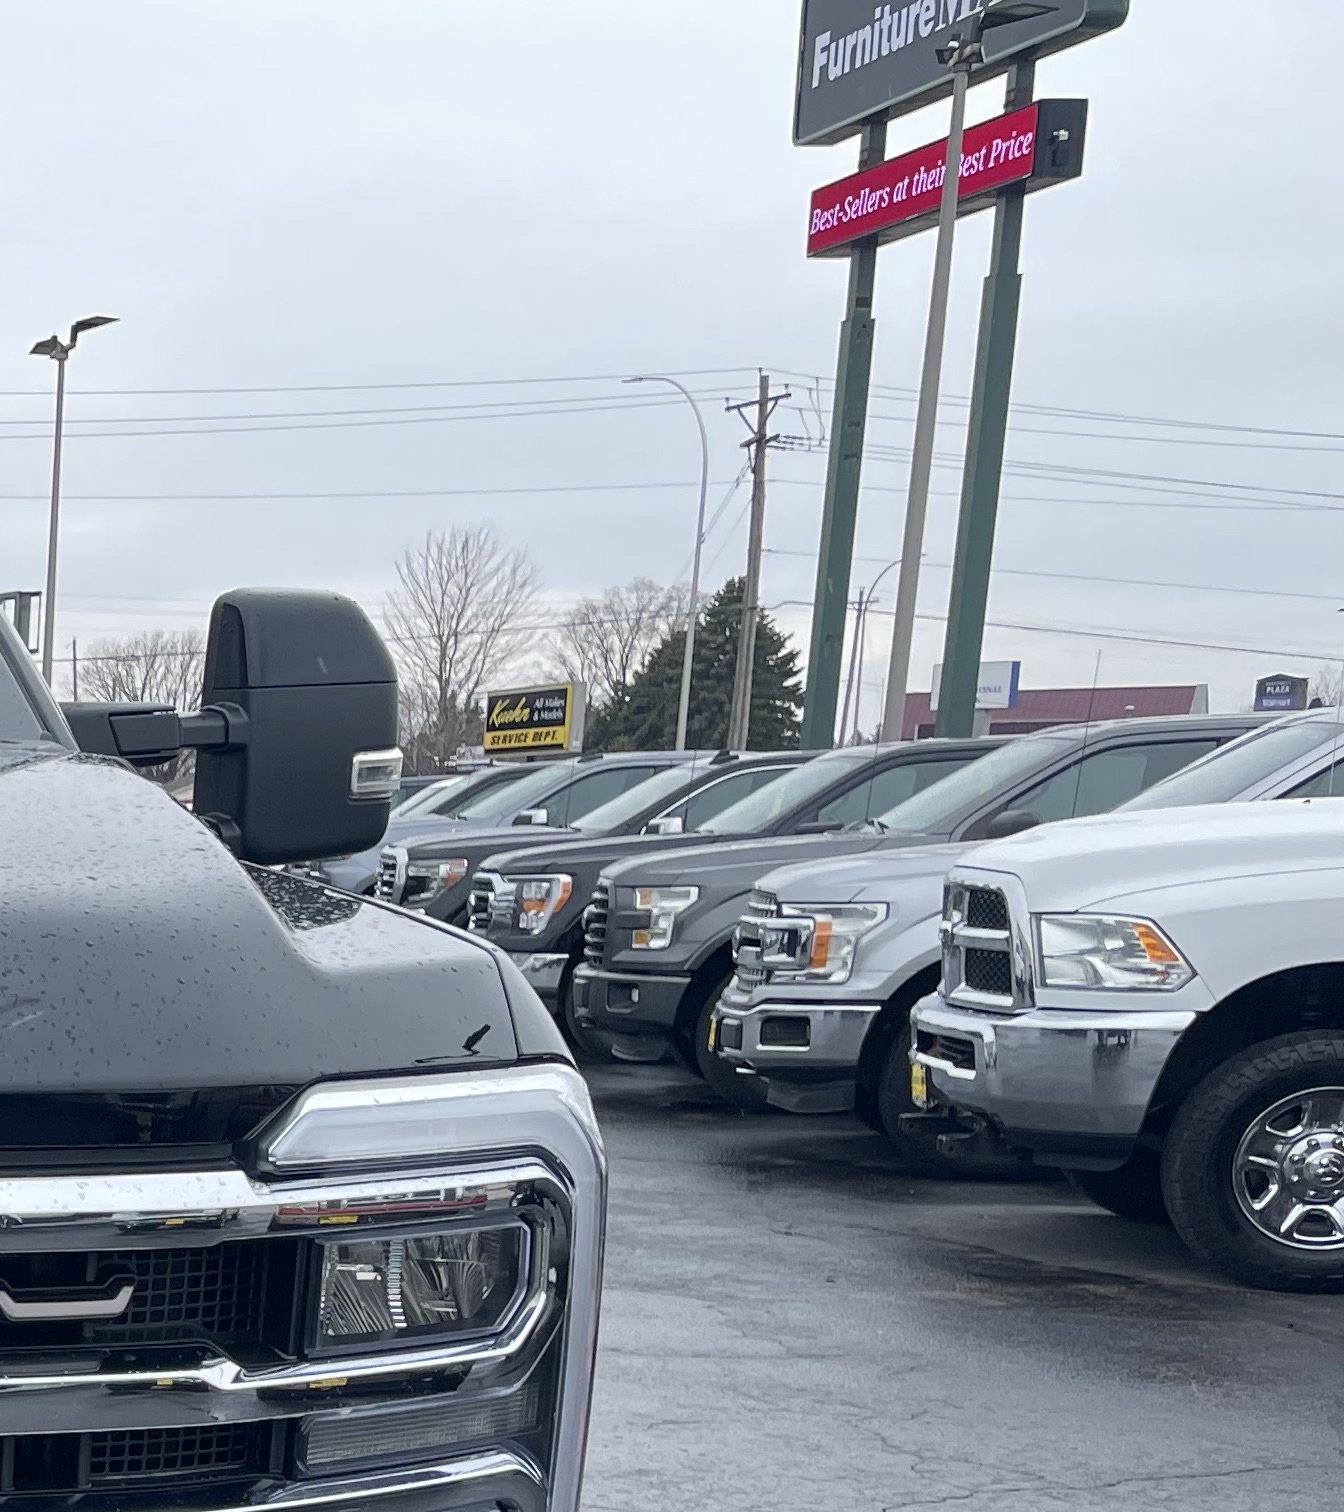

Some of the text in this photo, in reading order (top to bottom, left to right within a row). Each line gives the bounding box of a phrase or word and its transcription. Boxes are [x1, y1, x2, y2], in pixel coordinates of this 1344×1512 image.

[810, 188, 889, 235] Best-Sellers
[892, 176, 910, 204] at
[988, 131, 1033, 169] Price
[1266, 685, 1290, 694] PLAZA
[491, 731, 529, 746] SERVICE
